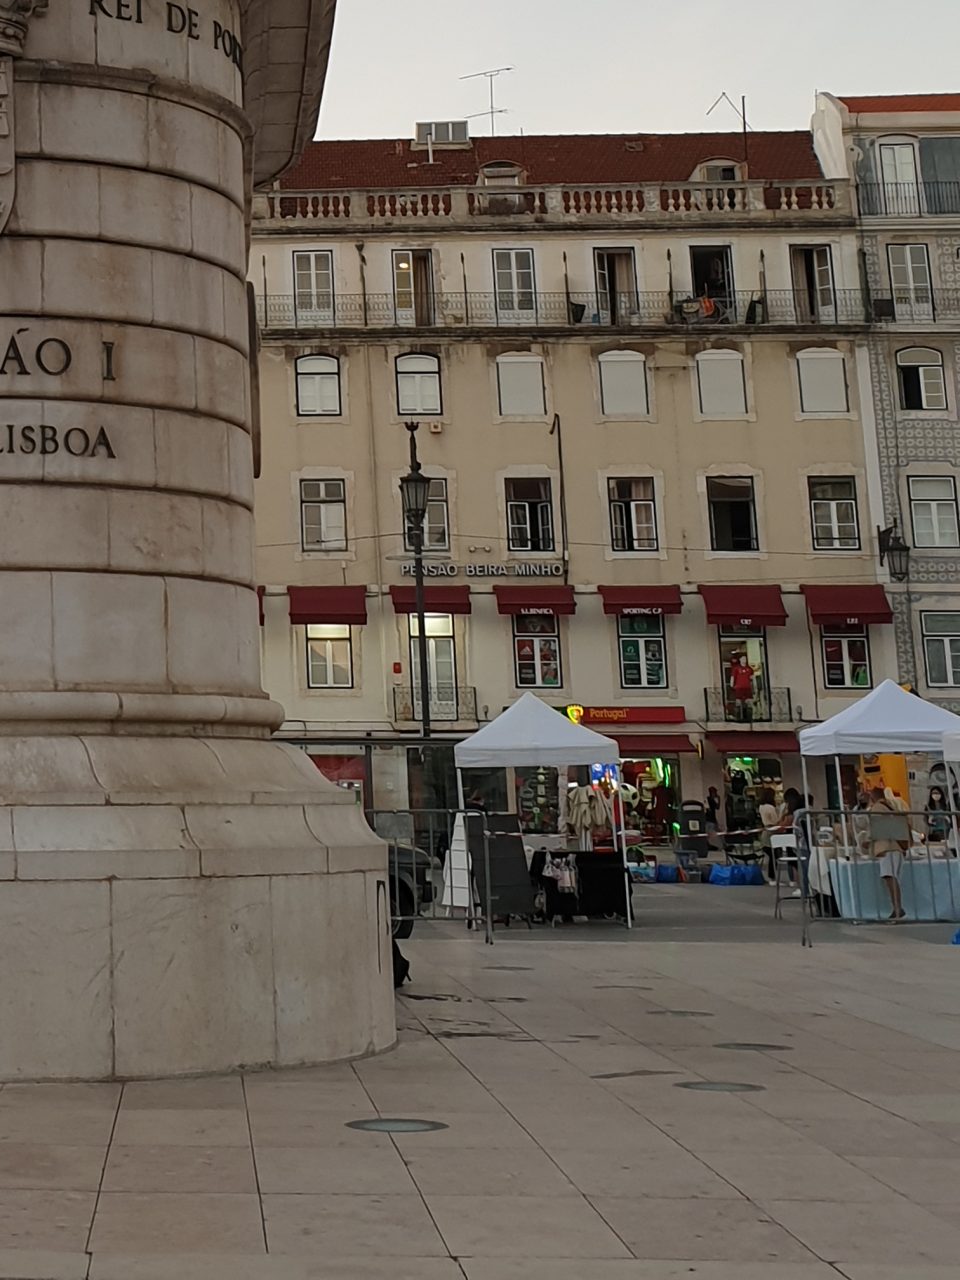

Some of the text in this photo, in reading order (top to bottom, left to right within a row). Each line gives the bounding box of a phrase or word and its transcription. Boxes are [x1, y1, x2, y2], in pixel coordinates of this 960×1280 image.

[166, 1, 200, 40] DE
[102, 341, 116, 381] I
[466, 563, 508, 577] BEIRA
[515, 563, 563, 577] MINHO
[589, 708, 627, 720] Portugal
